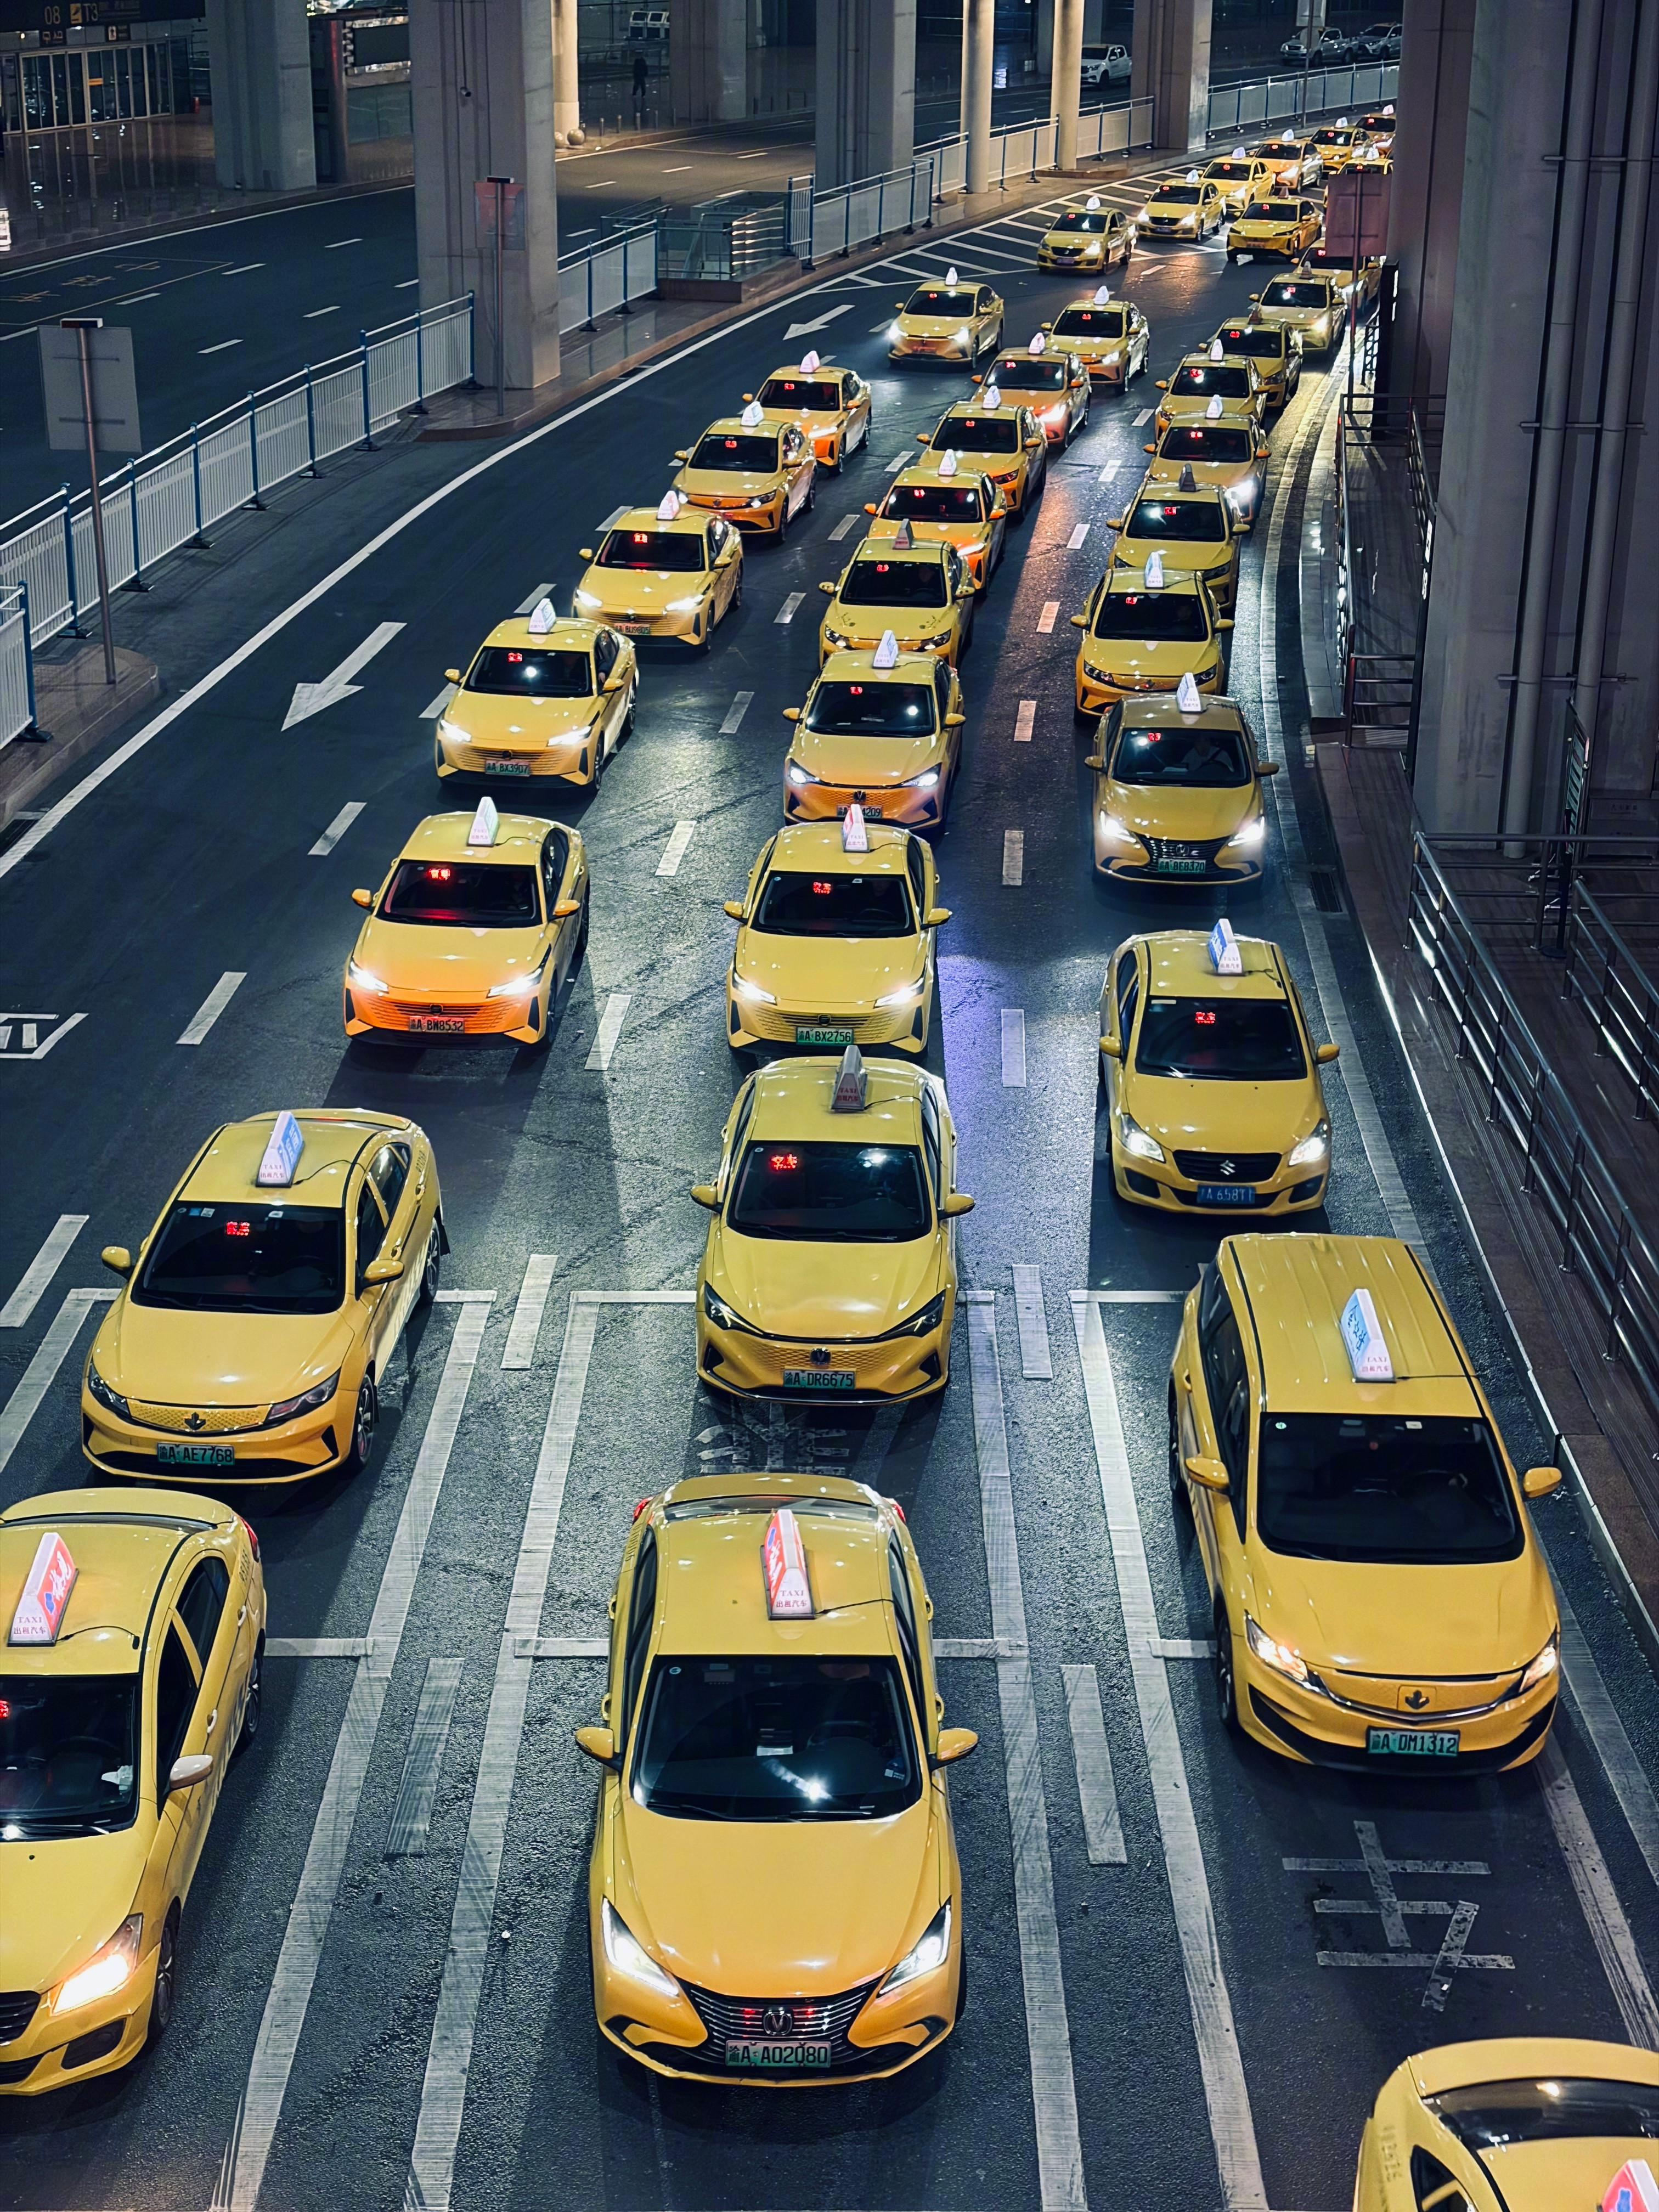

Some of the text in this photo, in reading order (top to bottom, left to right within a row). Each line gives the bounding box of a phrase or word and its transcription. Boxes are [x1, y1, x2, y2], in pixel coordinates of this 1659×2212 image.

[44, 6, 60, 25] 08
[83, 3, 99, 22] T3
[815, 1030, 851, 1043] BX2756
[807, 1373, 854, 1387] DR6675
[183, 1447, 233, 1463] AE7768
[776, 1599, 808, 1608] 出租汽车
[14, 1626, 46, 1634] 出租汽车
[1397, 1734, 1457, 1754] DM1312
[760, 2045, 828, 2064] A02080
